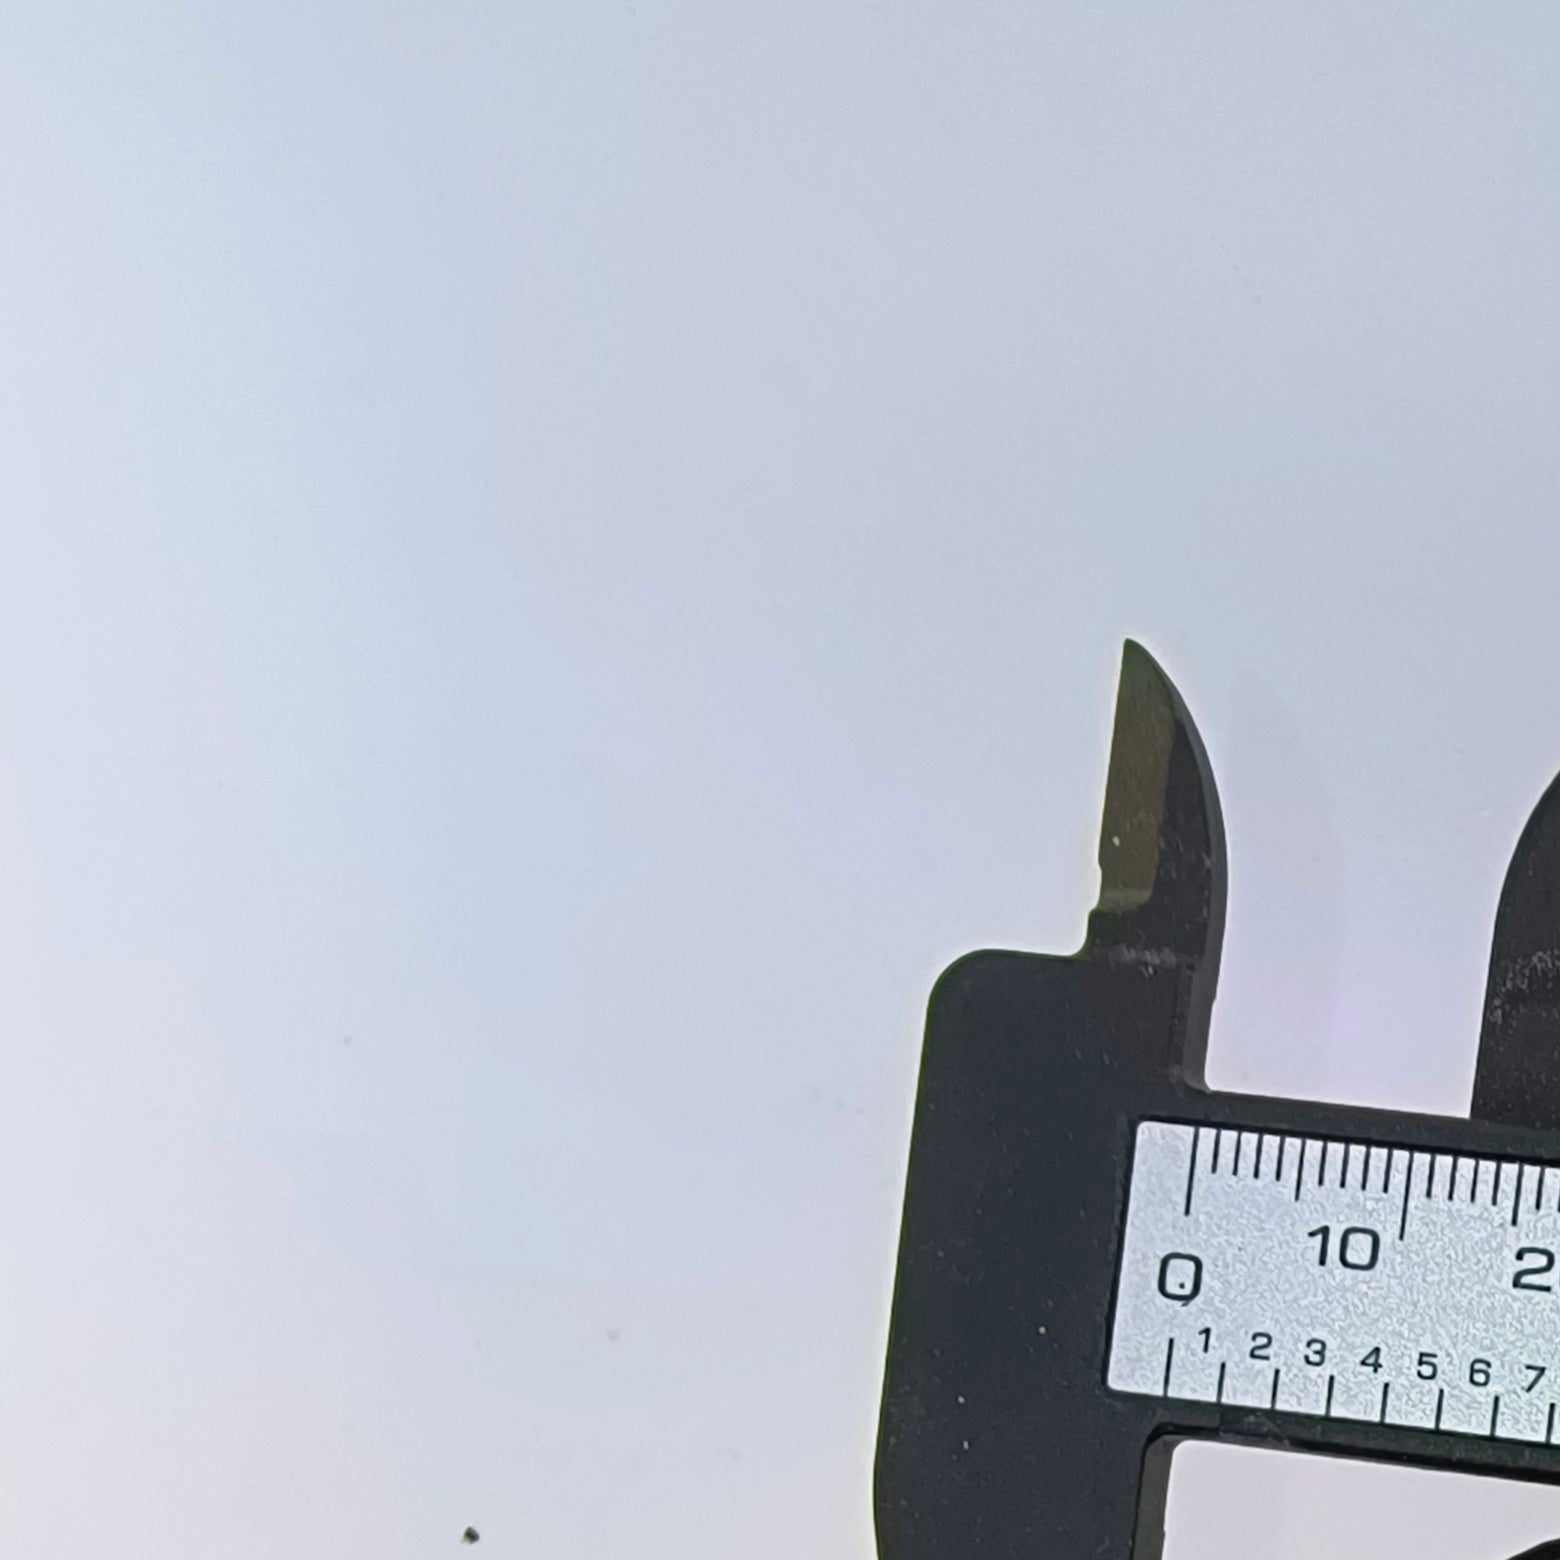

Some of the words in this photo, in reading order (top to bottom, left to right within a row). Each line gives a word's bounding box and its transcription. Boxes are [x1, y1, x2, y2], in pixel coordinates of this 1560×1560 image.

[1158, 1252, 1202, 1303] 0
[1306, 1225, 1381, 1271] 10
[1197, 1327, 1213, 1355] 1
[1250, 1332, 1272, 1360] 2
[1303, 1338, 1327, 1367] 3
[1360, 1346, 1382, 1374] 4
[1416, 1352, 1438, 1380] 5
[1468, 1358, 1492, 1388] 6
[1523, 1365, 1546, 1394] 7
